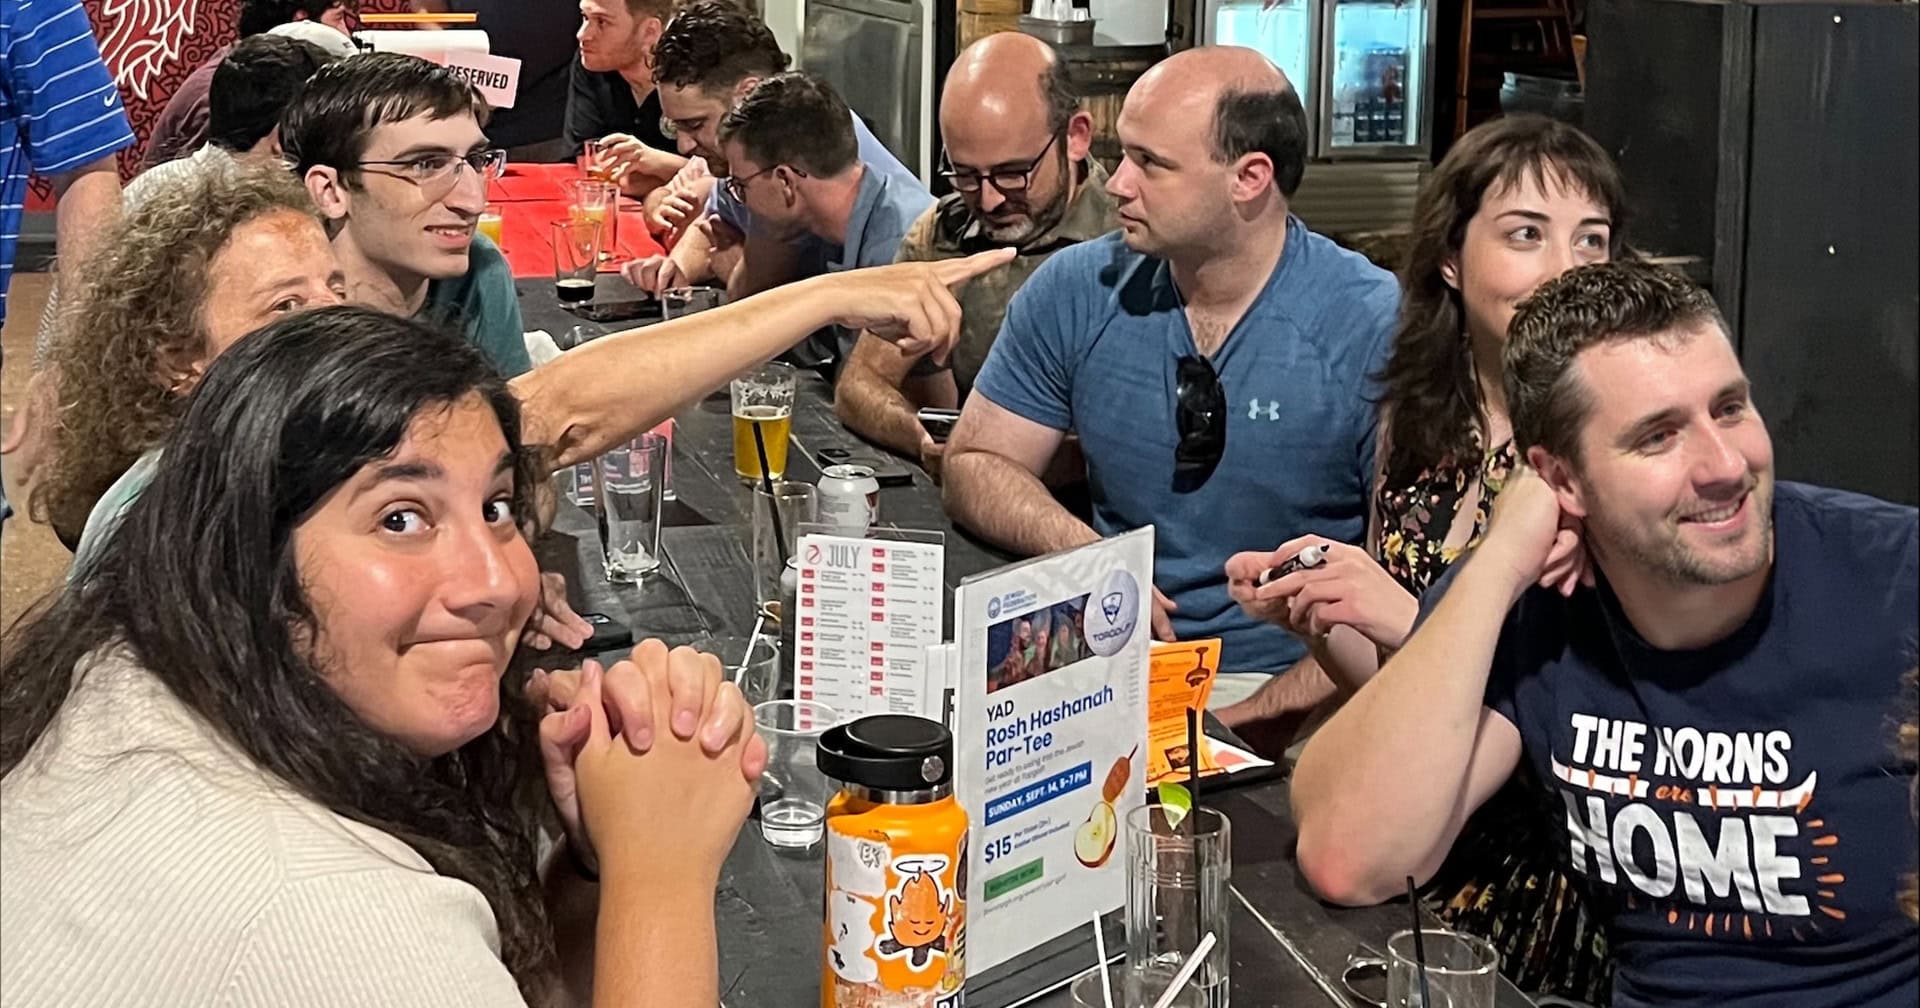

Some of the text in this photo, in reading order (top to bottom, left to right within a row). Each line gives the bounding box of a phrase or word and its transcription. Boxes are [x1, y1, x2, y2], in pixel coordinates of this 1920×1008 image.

[827, 544, 860, 569] JULY
[986, 700, 1014, 722] YAD
[986, 717, 1026, 748] Rosh
[1030, 685, 1113, 731] Hashanah
[986, 732, 1052, 770] Par-Tee
[1571, 713, 1792, 784] THE HORNS
[988, 795, 1025, 818] SUNDAY,
[1074, 769, 1088, 784] PM
[985, 835, 1011, 864] $15
[1559, 788, 1811, 916] HOME
